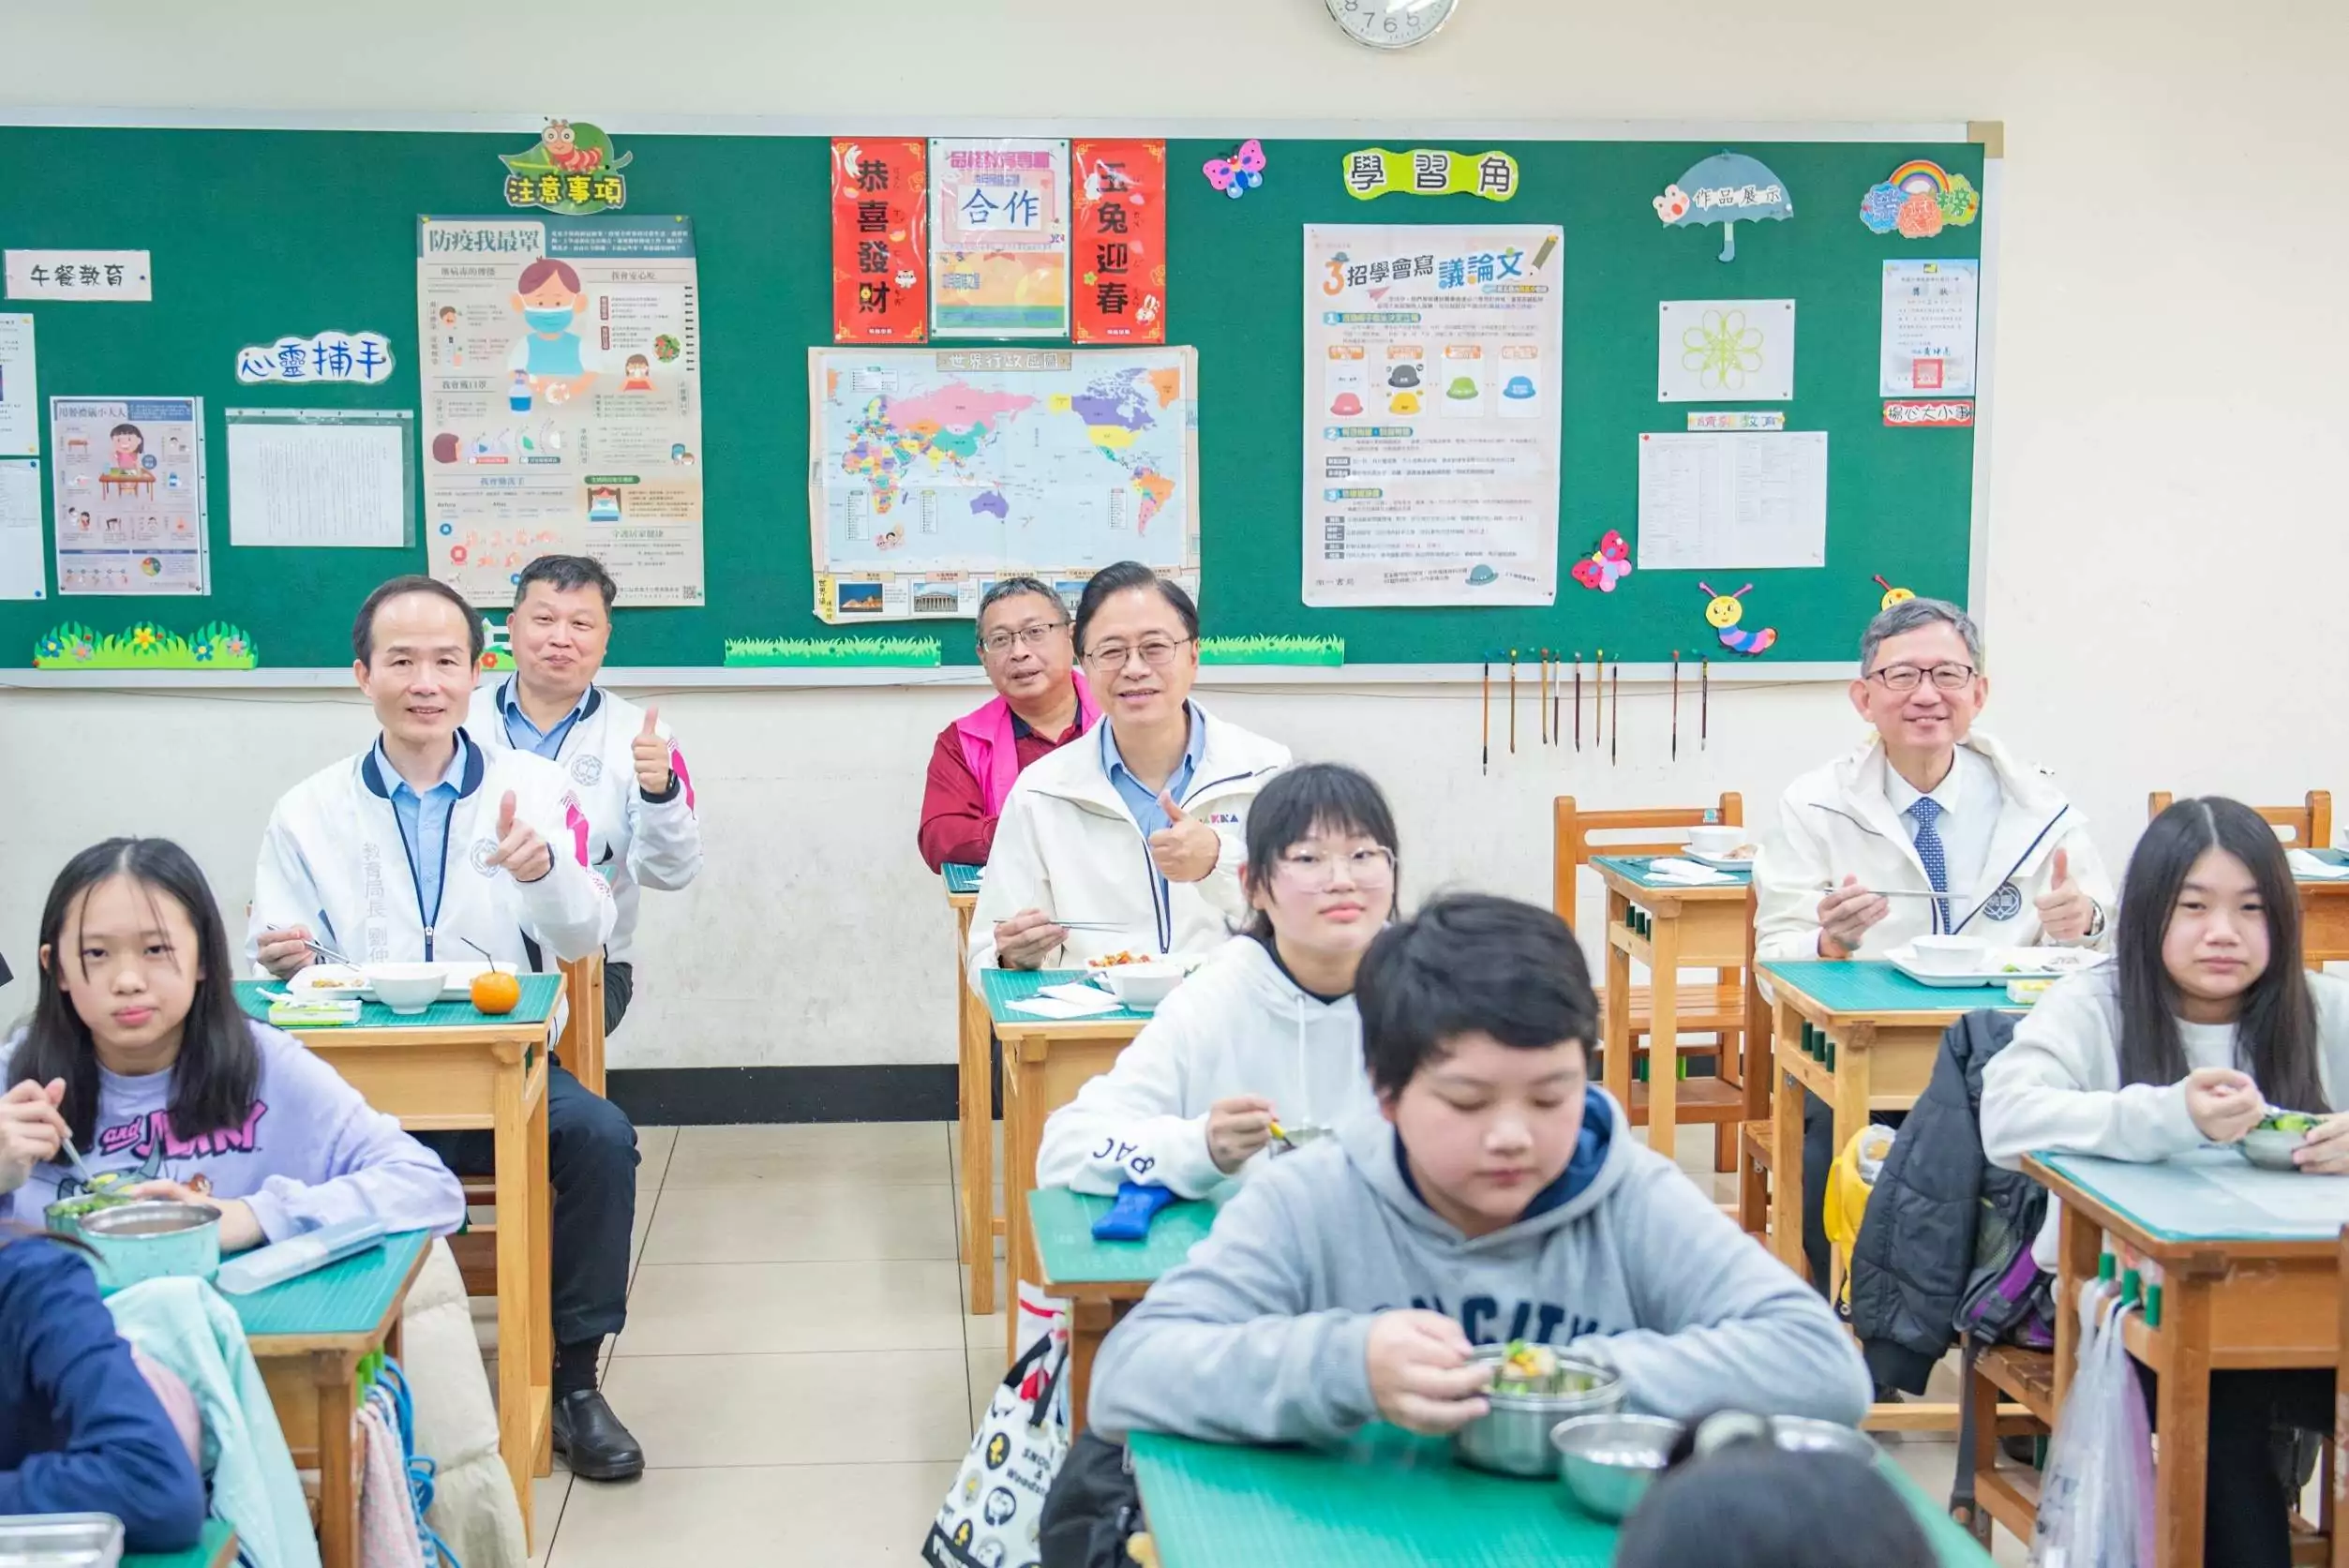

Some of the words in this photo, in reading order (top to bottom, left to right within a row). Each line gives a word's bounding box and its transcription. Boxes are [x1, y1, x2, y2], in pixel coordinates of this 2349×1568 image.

[1363, 12, 1375, 28] 7
[1384, 18, 1398, 33] 6
[1352, 154, 1511, 192] 學習角
[509, 174, 623, 204] 注意事項
[1695, 185, 1781, 206] 作品展示
[961, 187, 1040, 227] 合作
[429, 229, 540, 252] 防疫我最罩
[857, 159, 890, 314] 恭喜發財
[30, 264, 125, 287] 午餐教育
[241, 340, 386, 379] 心靈捕手
[950, 352, 1058, 369] 世界行政區圖
[99, 1115, 142, 1148] and
